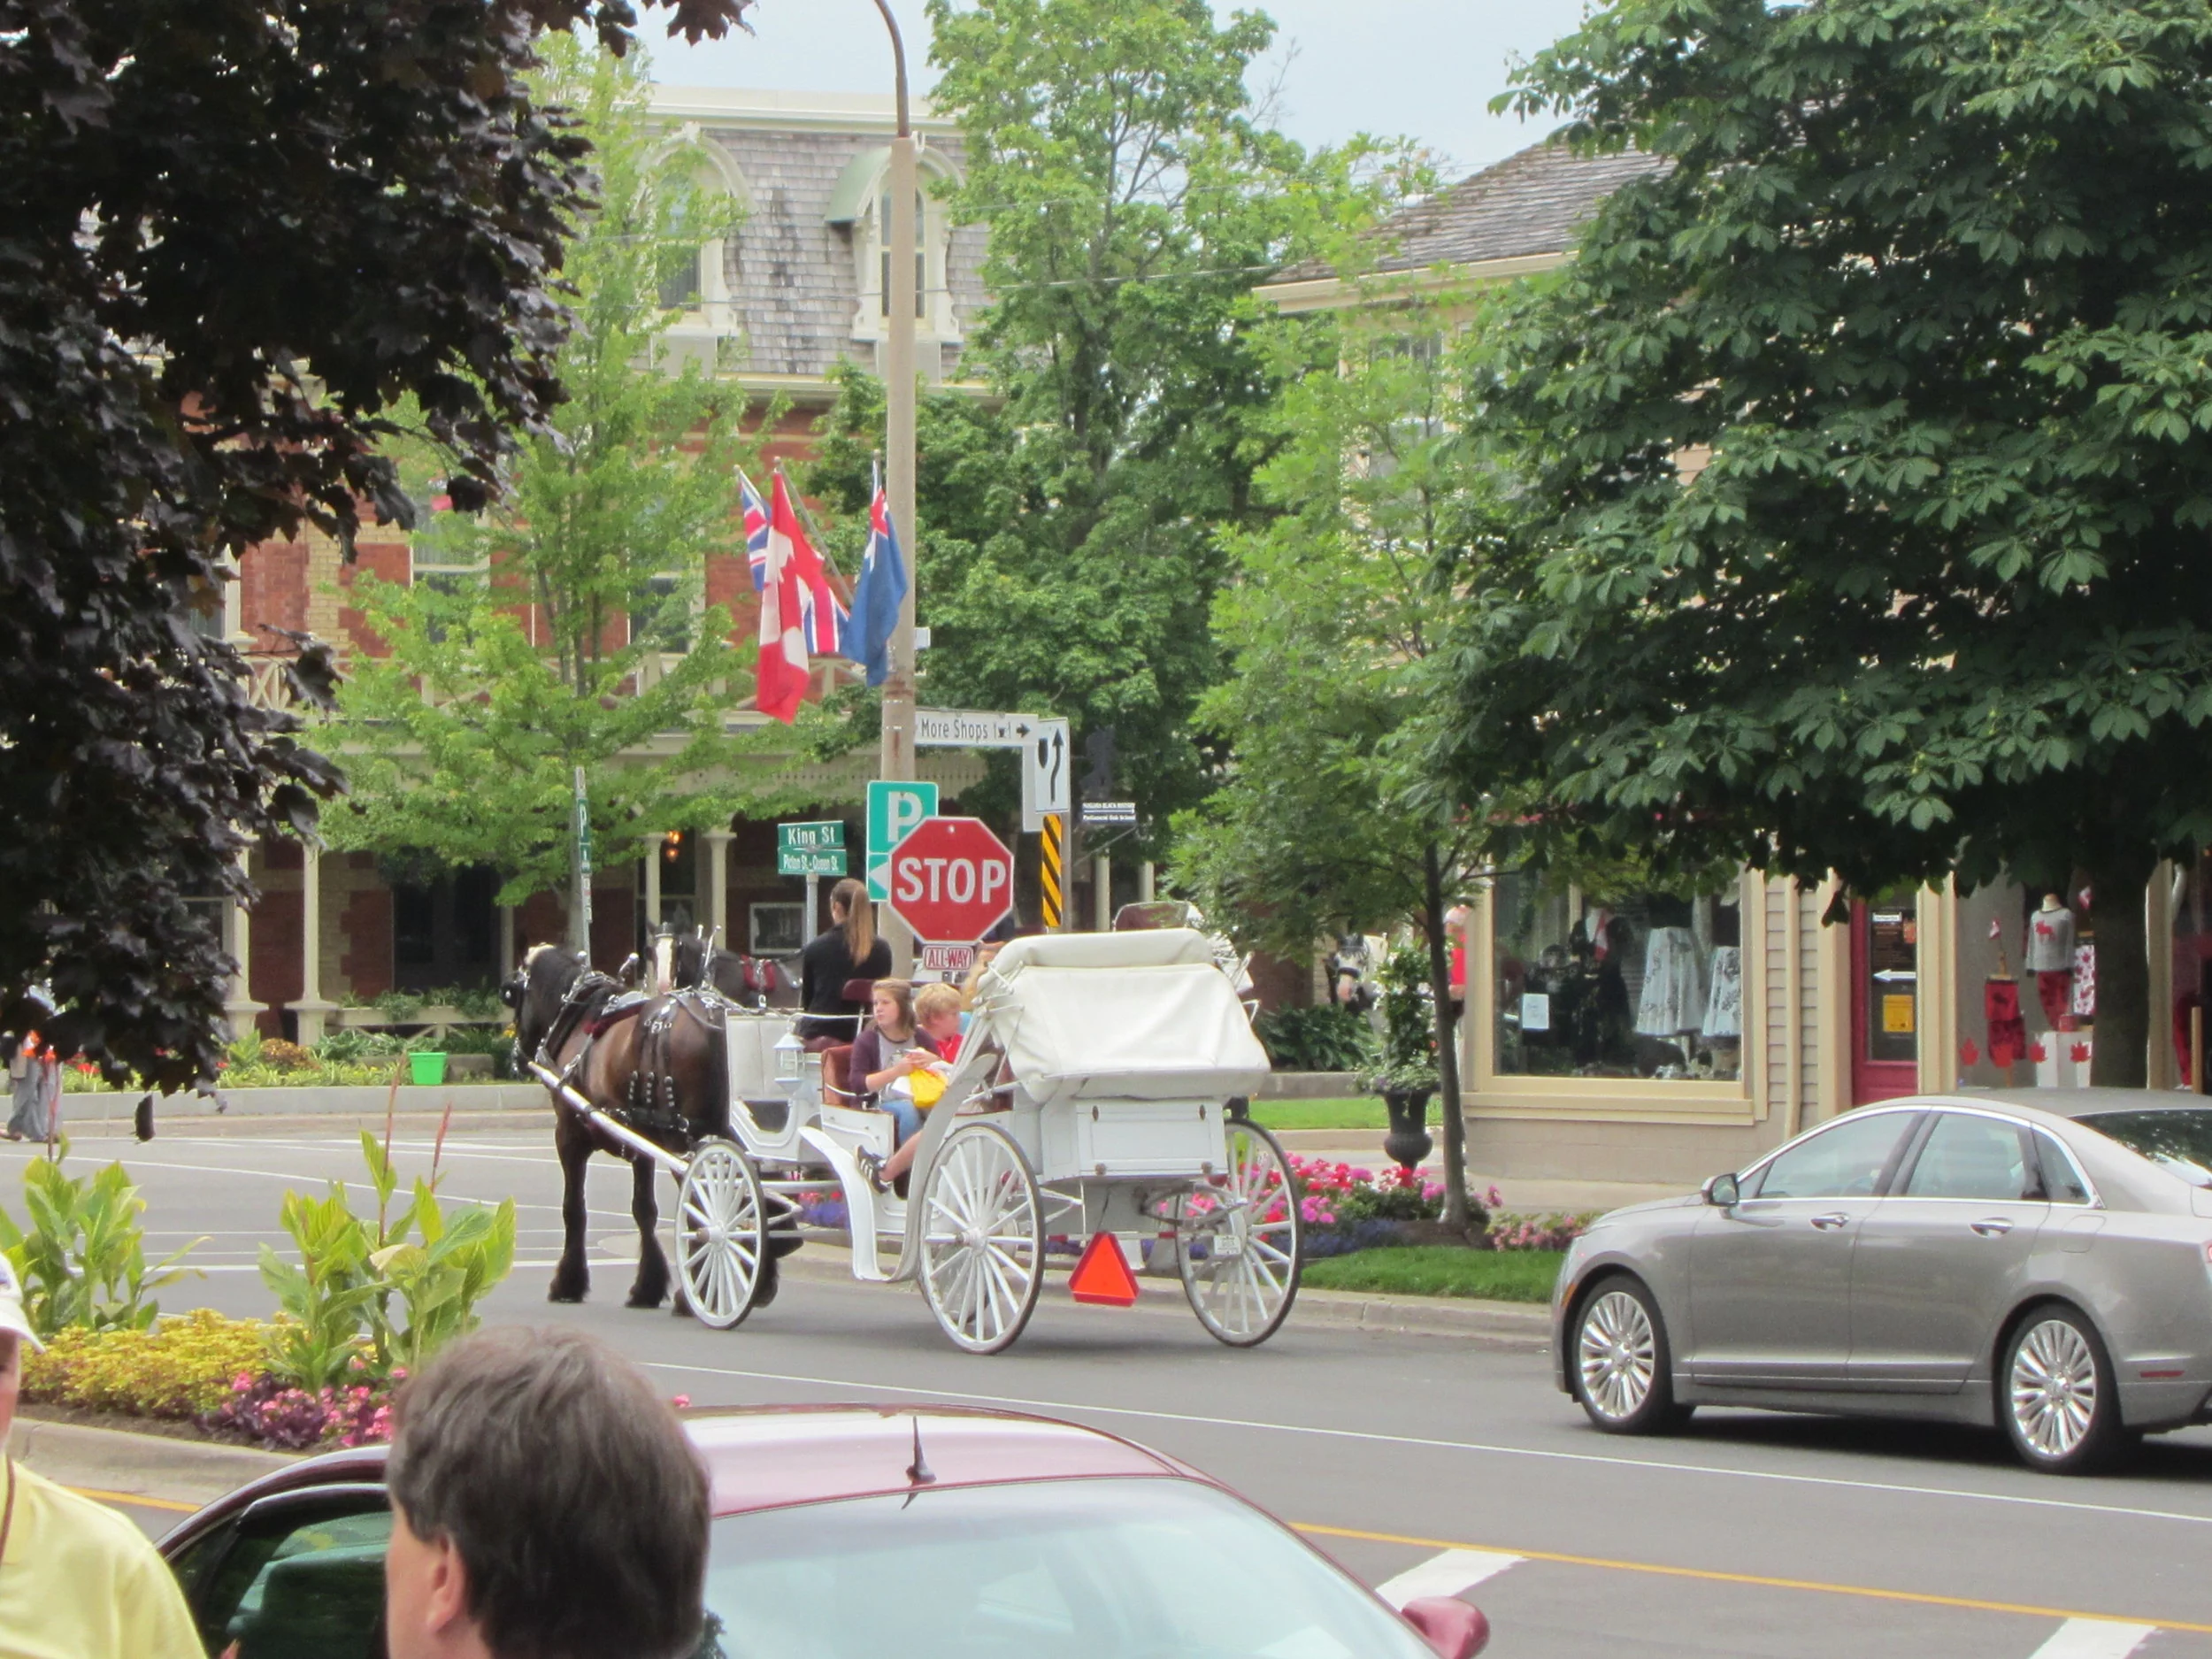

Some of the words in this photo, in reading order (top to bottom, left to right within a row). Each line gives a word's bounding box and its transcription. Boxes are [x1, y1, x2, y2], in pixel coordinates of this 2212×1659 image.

[921, 718, 949, 739] More
[953, 719, 988, 743] Shops
[887, 791, 923, 842] P
[787, 827, 817, 845] King
[821, 826, 835, 843] St
[896, 857, 1007, 904] STOP
[928, 949, 970, 967] ALL-WAY
